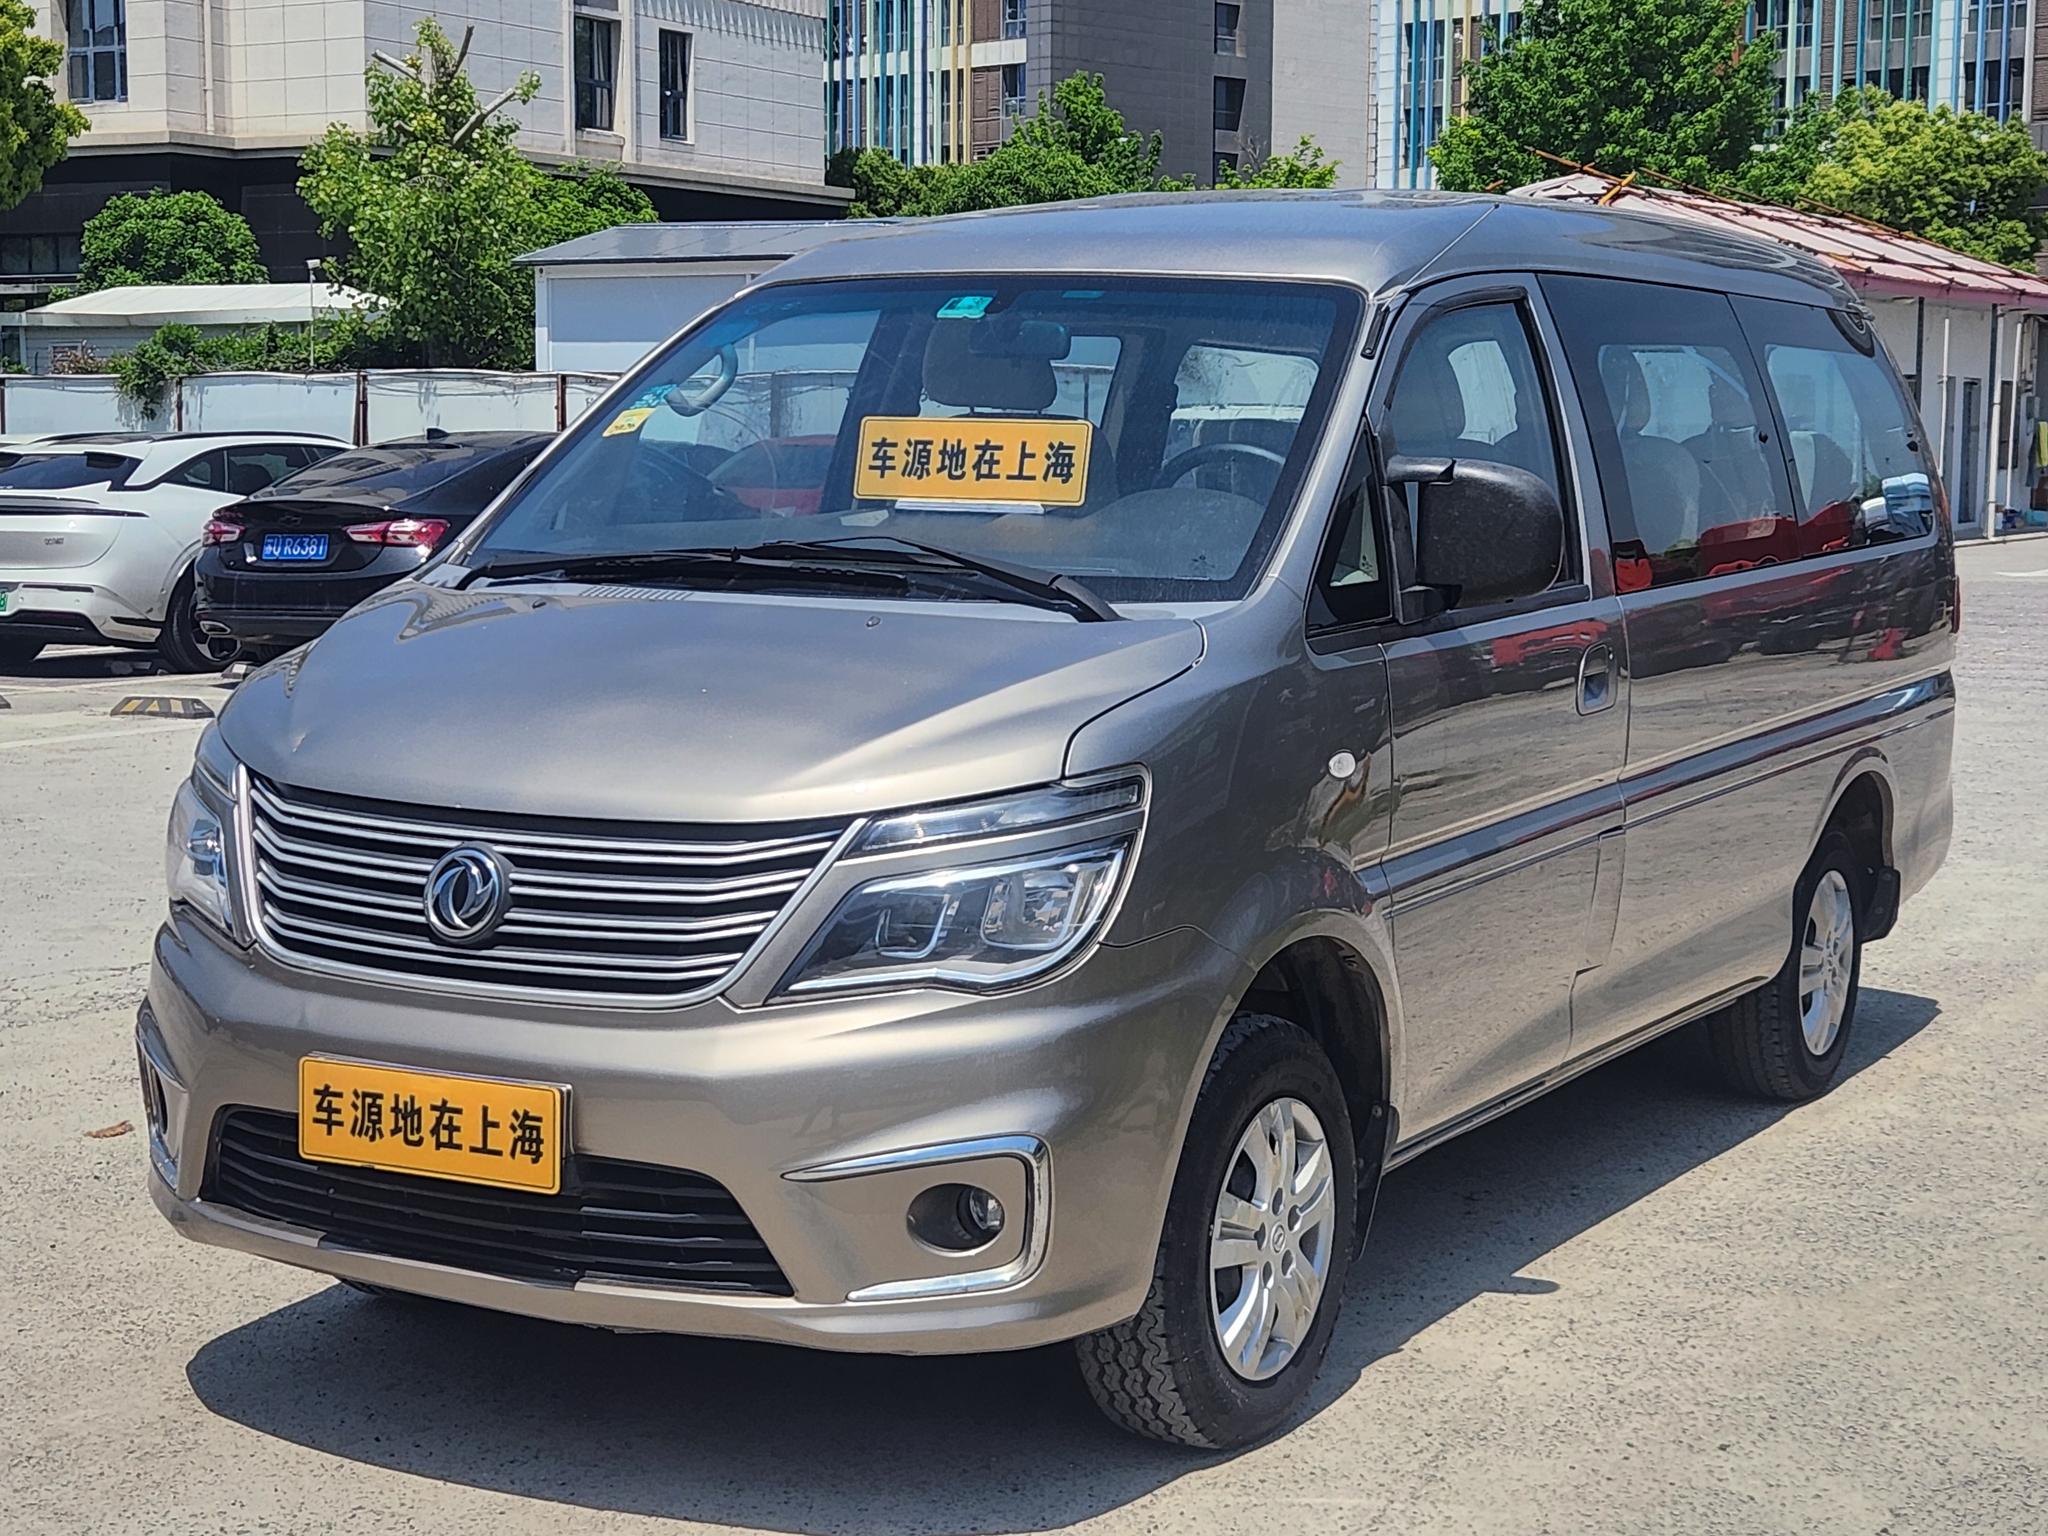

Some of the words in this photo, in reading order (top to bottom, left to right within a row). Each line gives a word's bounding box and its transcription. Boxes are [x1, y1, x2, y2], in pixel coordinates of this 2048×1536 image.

[868, 437, 1076, 484] 车源地在上海
[312, 1084, 545, 1164] 车源地在上海
